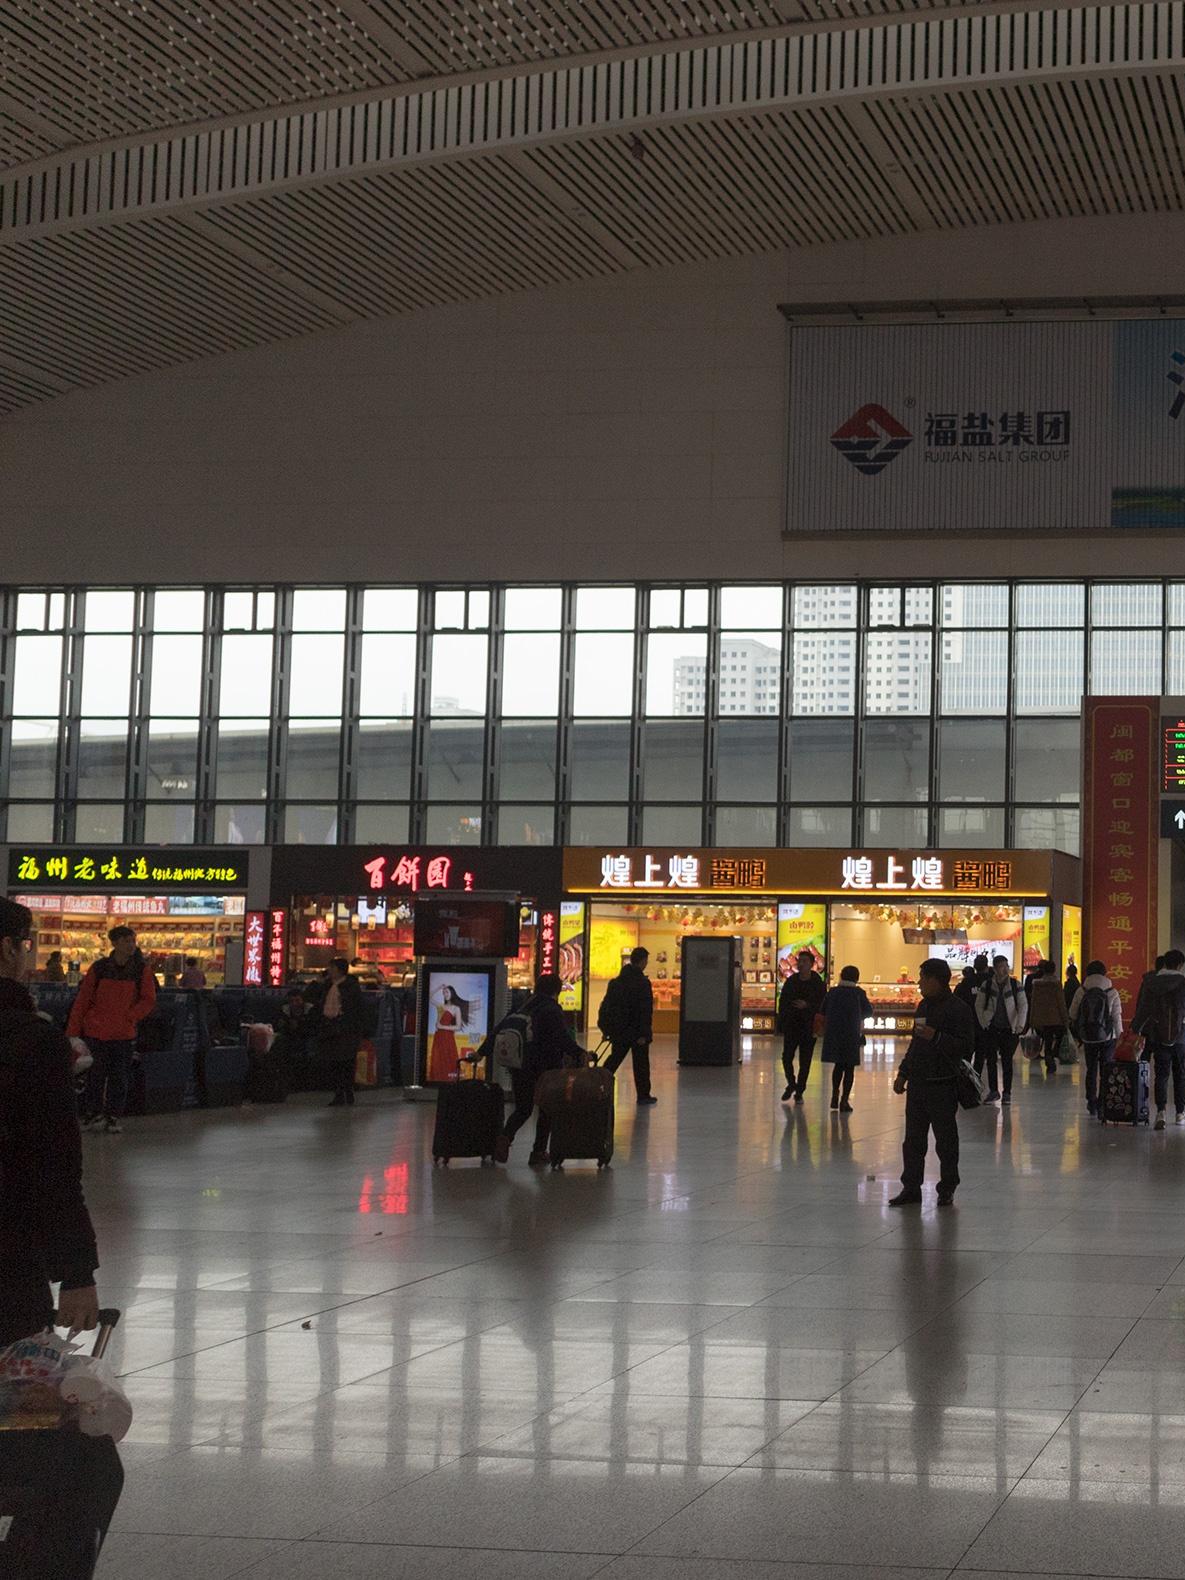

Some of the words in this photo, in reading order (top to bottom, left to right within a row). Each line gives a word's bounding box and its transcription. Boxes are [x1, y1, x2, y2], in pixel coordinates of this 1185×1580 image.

[924, 409, 1071, 446] 福盐集团
[17, 856, 149, 880] 福州老味道
[600, 854, 698, 888] 煌上煌
[711, 858, 766, 888] 酱鸭
[841, 855, 944, 889] 煌上煌
[953, 860, 1012, 889] 酱鸭
